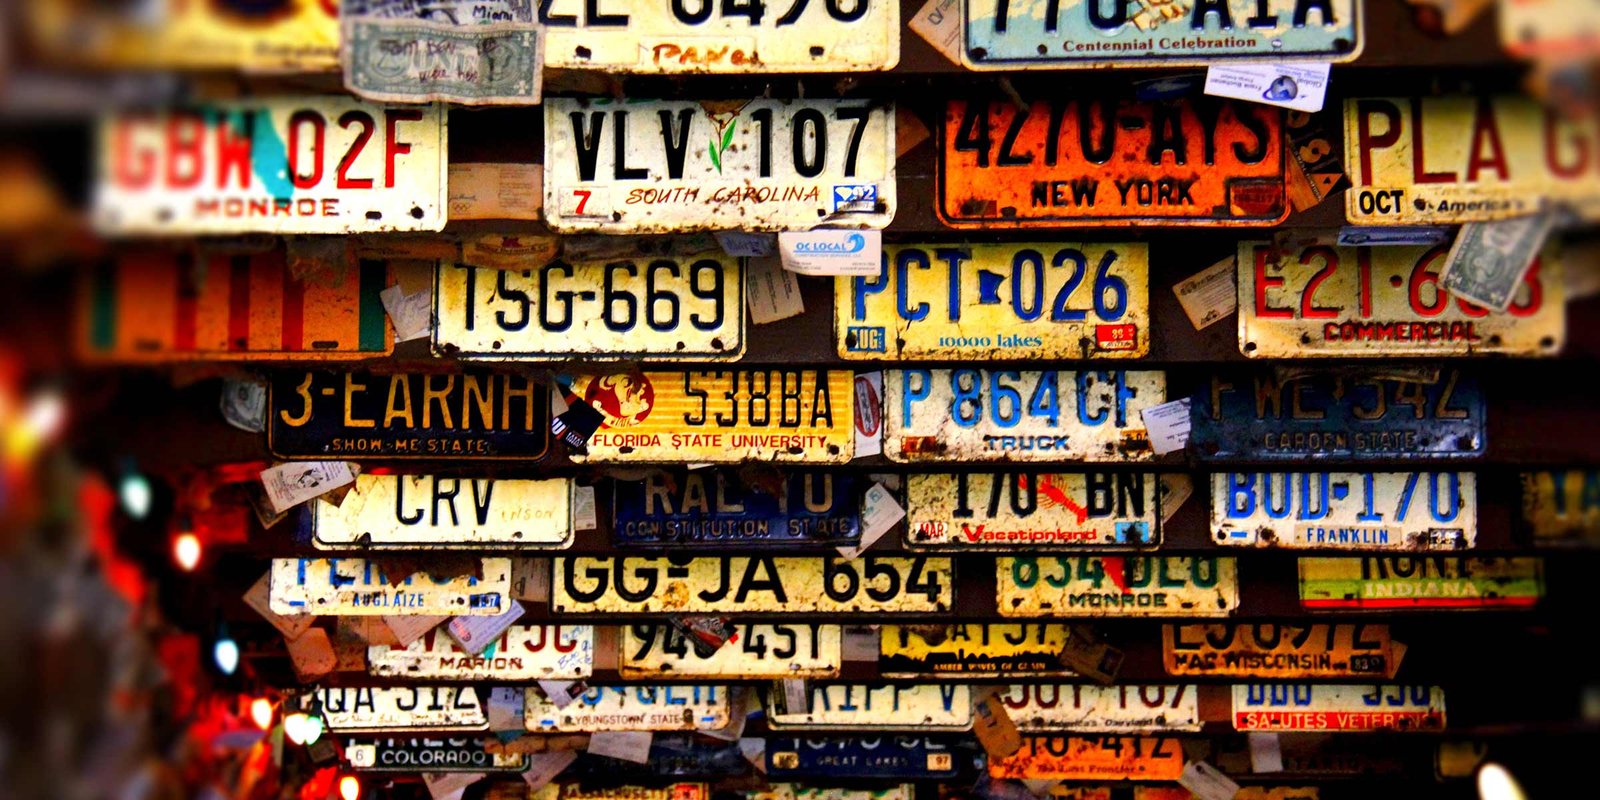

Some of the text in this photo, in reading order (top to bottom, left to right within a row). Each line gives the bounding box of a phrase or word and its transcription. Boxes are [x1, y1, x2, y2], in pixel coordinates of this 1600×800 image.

[473, 5, 513, 21] Miami
[1063, 35, 1257, 52] Centennial Celebration
[569, 107, 872, 181] VLV 107
[1357, 101, 1508, 186] PLA
[573, 190, 590, 214] 7
[626, 186, 820, 205] SOUTH CAROLINA
[1032, 180, 1194, 207] NEW YORK
[1359, 189, 1404, 214] OCT
[198, 197, 341, 218] MONROE
[795, 242, 847, 251] OC LOCAL
[851, 248, 972, 322] PCT
[1010, 248, 1128, 323] 026
[454, 258, 725, 333] TSG-669
[939, 333, 1042, 348] 10000 lakes
[1324, 322, 1481, 342] COMMERCIAL
[902, 369, 932, 429] P
[950, 369, 1058, 428] 864
[332, 438, 487, 453] SHOW-ME STATE
[593, 434, 827, 449] FLORIDA STATE UNIVERSITY
[985, 434, 1070, 450] TRUCK
[1352, 432, 1415, 450] STATE
[626, 518, 850, 538] CONSTITUTION STATE
[962, 524, 1097, 542] Vacationland
[1306, 527, 1390, 544] FRANKLIN
[1363, 582, 1480, 597] INDIANA
[352, 592, 425, 607] AUGLAIZE
[1069, 593, 1168, 608] MONROE
[439, 656, 524, 670] MARION
[1223, 653, 1332, 671] WISCONSIN
[574, 713, 682, 724] YOUNGSTOWN STATE
[1247, 713, 1328, 729] SALUTES
[381, 750, 487, 765] COLORADO
